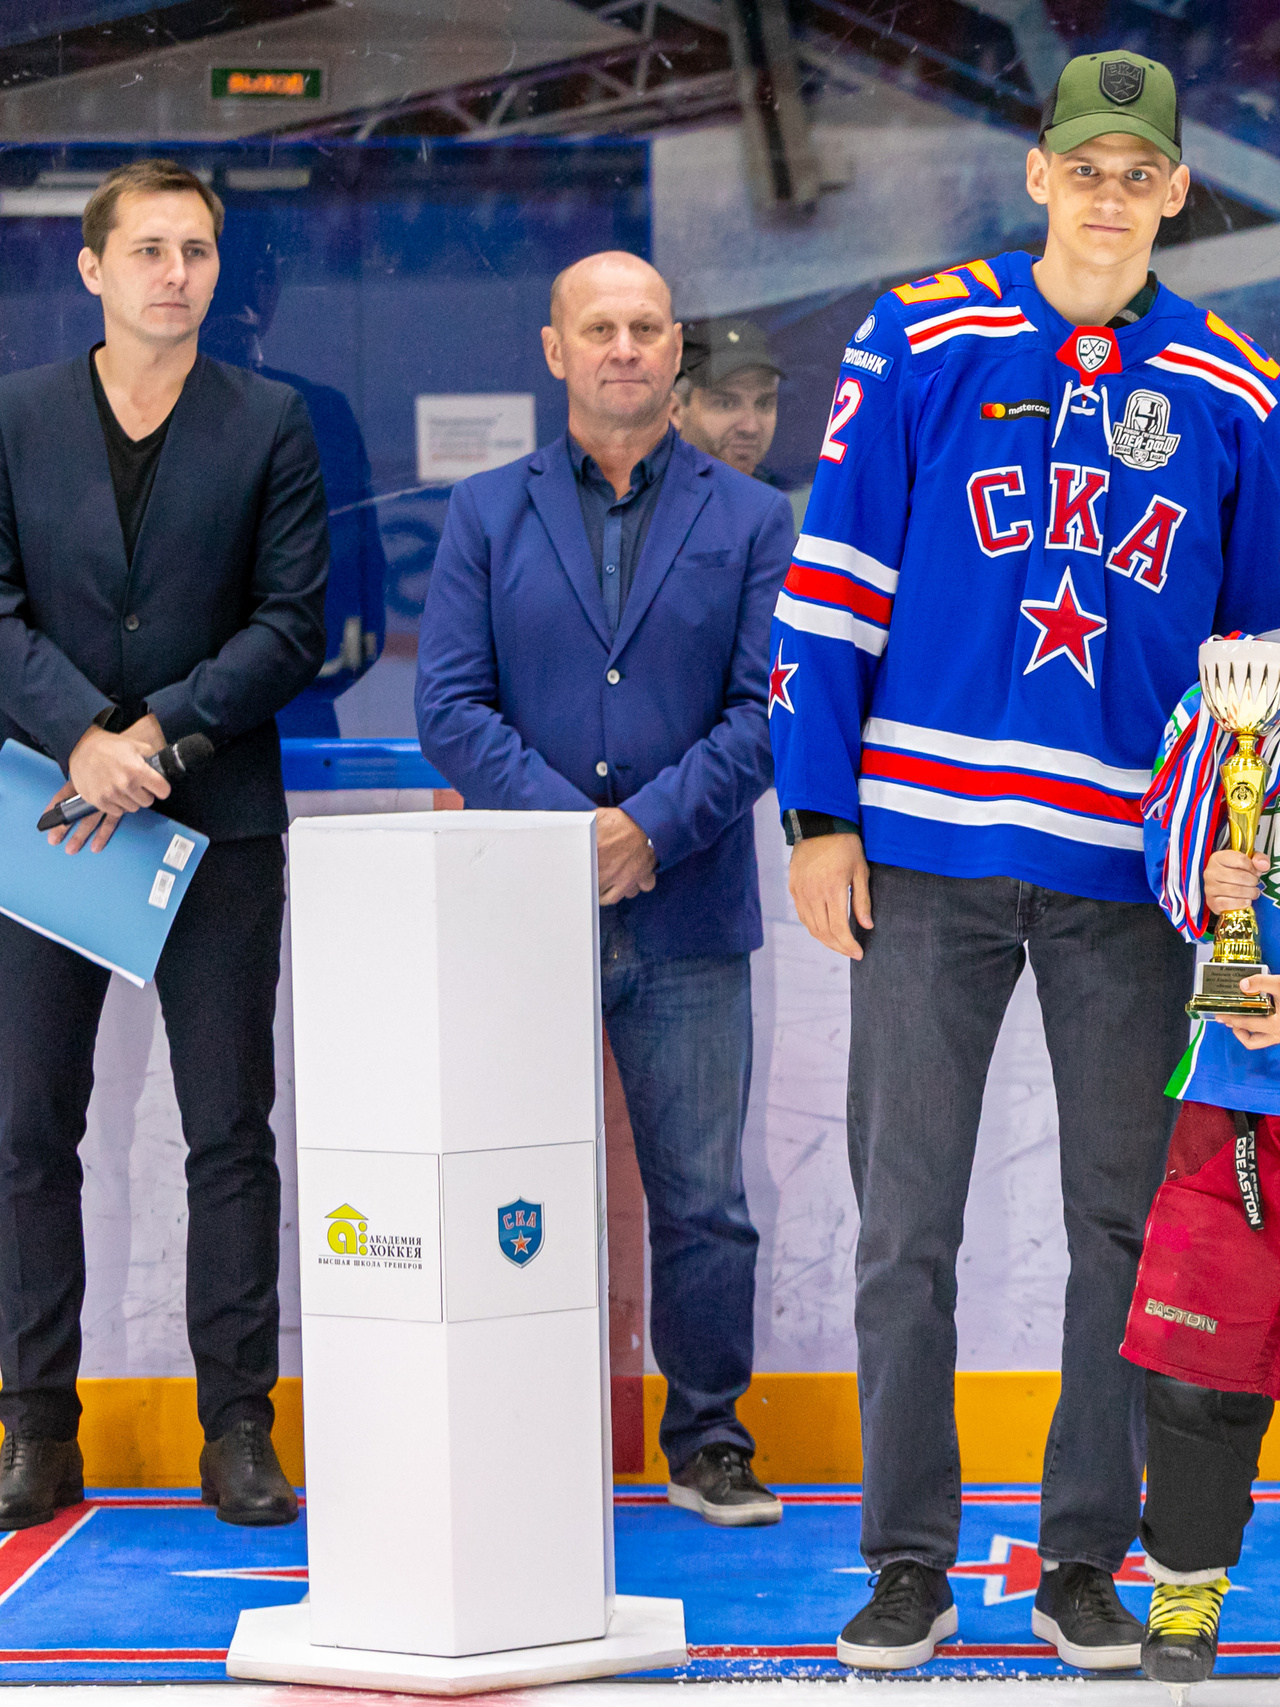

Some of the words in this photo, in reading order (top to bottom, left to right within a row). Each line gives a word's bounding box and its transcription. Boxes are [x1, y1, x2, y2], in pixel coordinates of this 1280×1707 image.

[1105, 63, 1141, 81] СКА
[1008, 402, 1050, 415] mastercard
[819, 377, 864, 465] 2
[966, 462, 1188, 594] СКА
[1236, 1159, 1261, 1225] EASTON
[503, 1210, 536, 1230] СКА
[369, 1235, 422, 1247] АКАДЕМИЯ
[370, 1244, 422, 1259] ХОККЕЯ
[318, 1257, 351, 1266] ВЫСШАЯ
[354, 1260, 381, 1268] ШКОЛА
[384, 1261, 423, 1270] ТРЕНЕРОВ
[1145, 1297, 1218, 1335] EASTON
